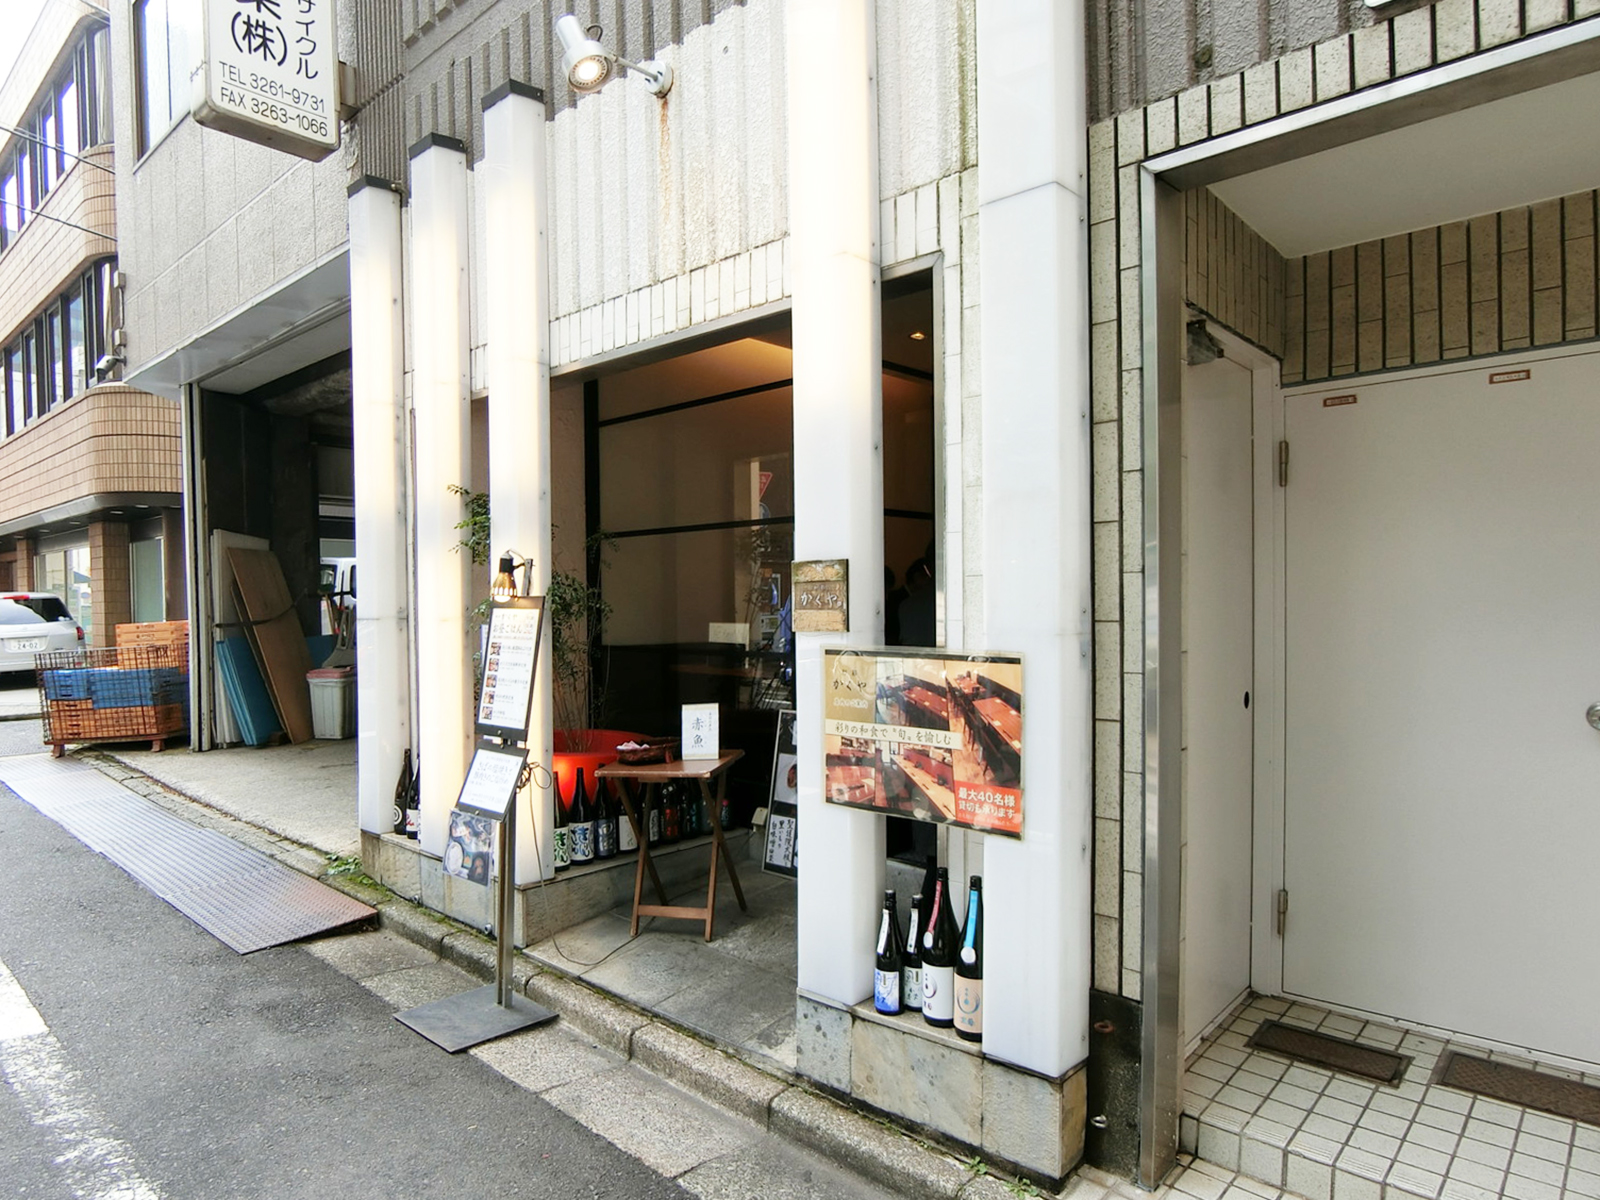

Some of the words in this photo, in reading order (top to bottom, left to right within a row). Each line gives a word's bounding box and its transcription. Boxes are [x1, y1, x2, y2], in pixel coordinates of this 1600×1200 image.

[219, 61, 246, 86] TEL
[250, 73, 325, 113] 3261-9731
[220, 87, 247, 110] FAX
[251, 97, 328, 138] 3263-1066
[958, 787, 1016, 807] 最大40名様
